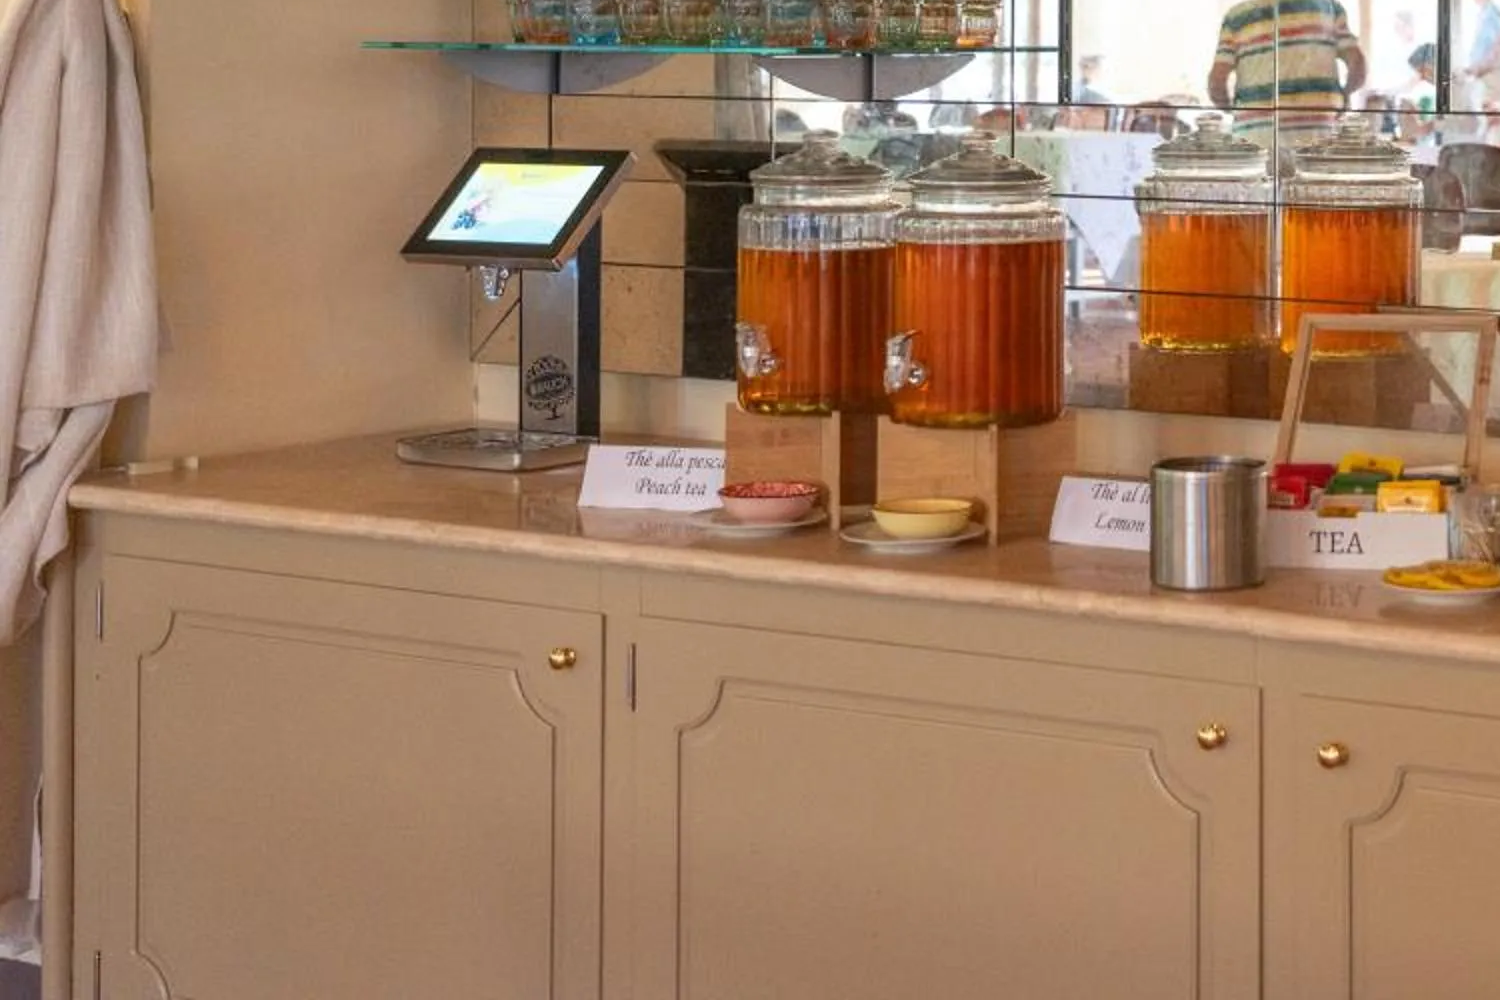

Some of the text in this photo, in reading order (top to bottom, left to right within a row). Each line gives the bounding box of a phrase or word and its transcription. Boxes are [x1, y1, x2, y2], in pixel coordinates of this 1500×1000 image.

[655, 449, 684, 468] alla
[685, 456, 726, 474] pesca
[635, 475, 707, 496] Peach tea
[1121, 482, 1139, 503] al
[1095, 512, 1145, 533] Lemon
[1309, 530, 1364, 554] TEA
